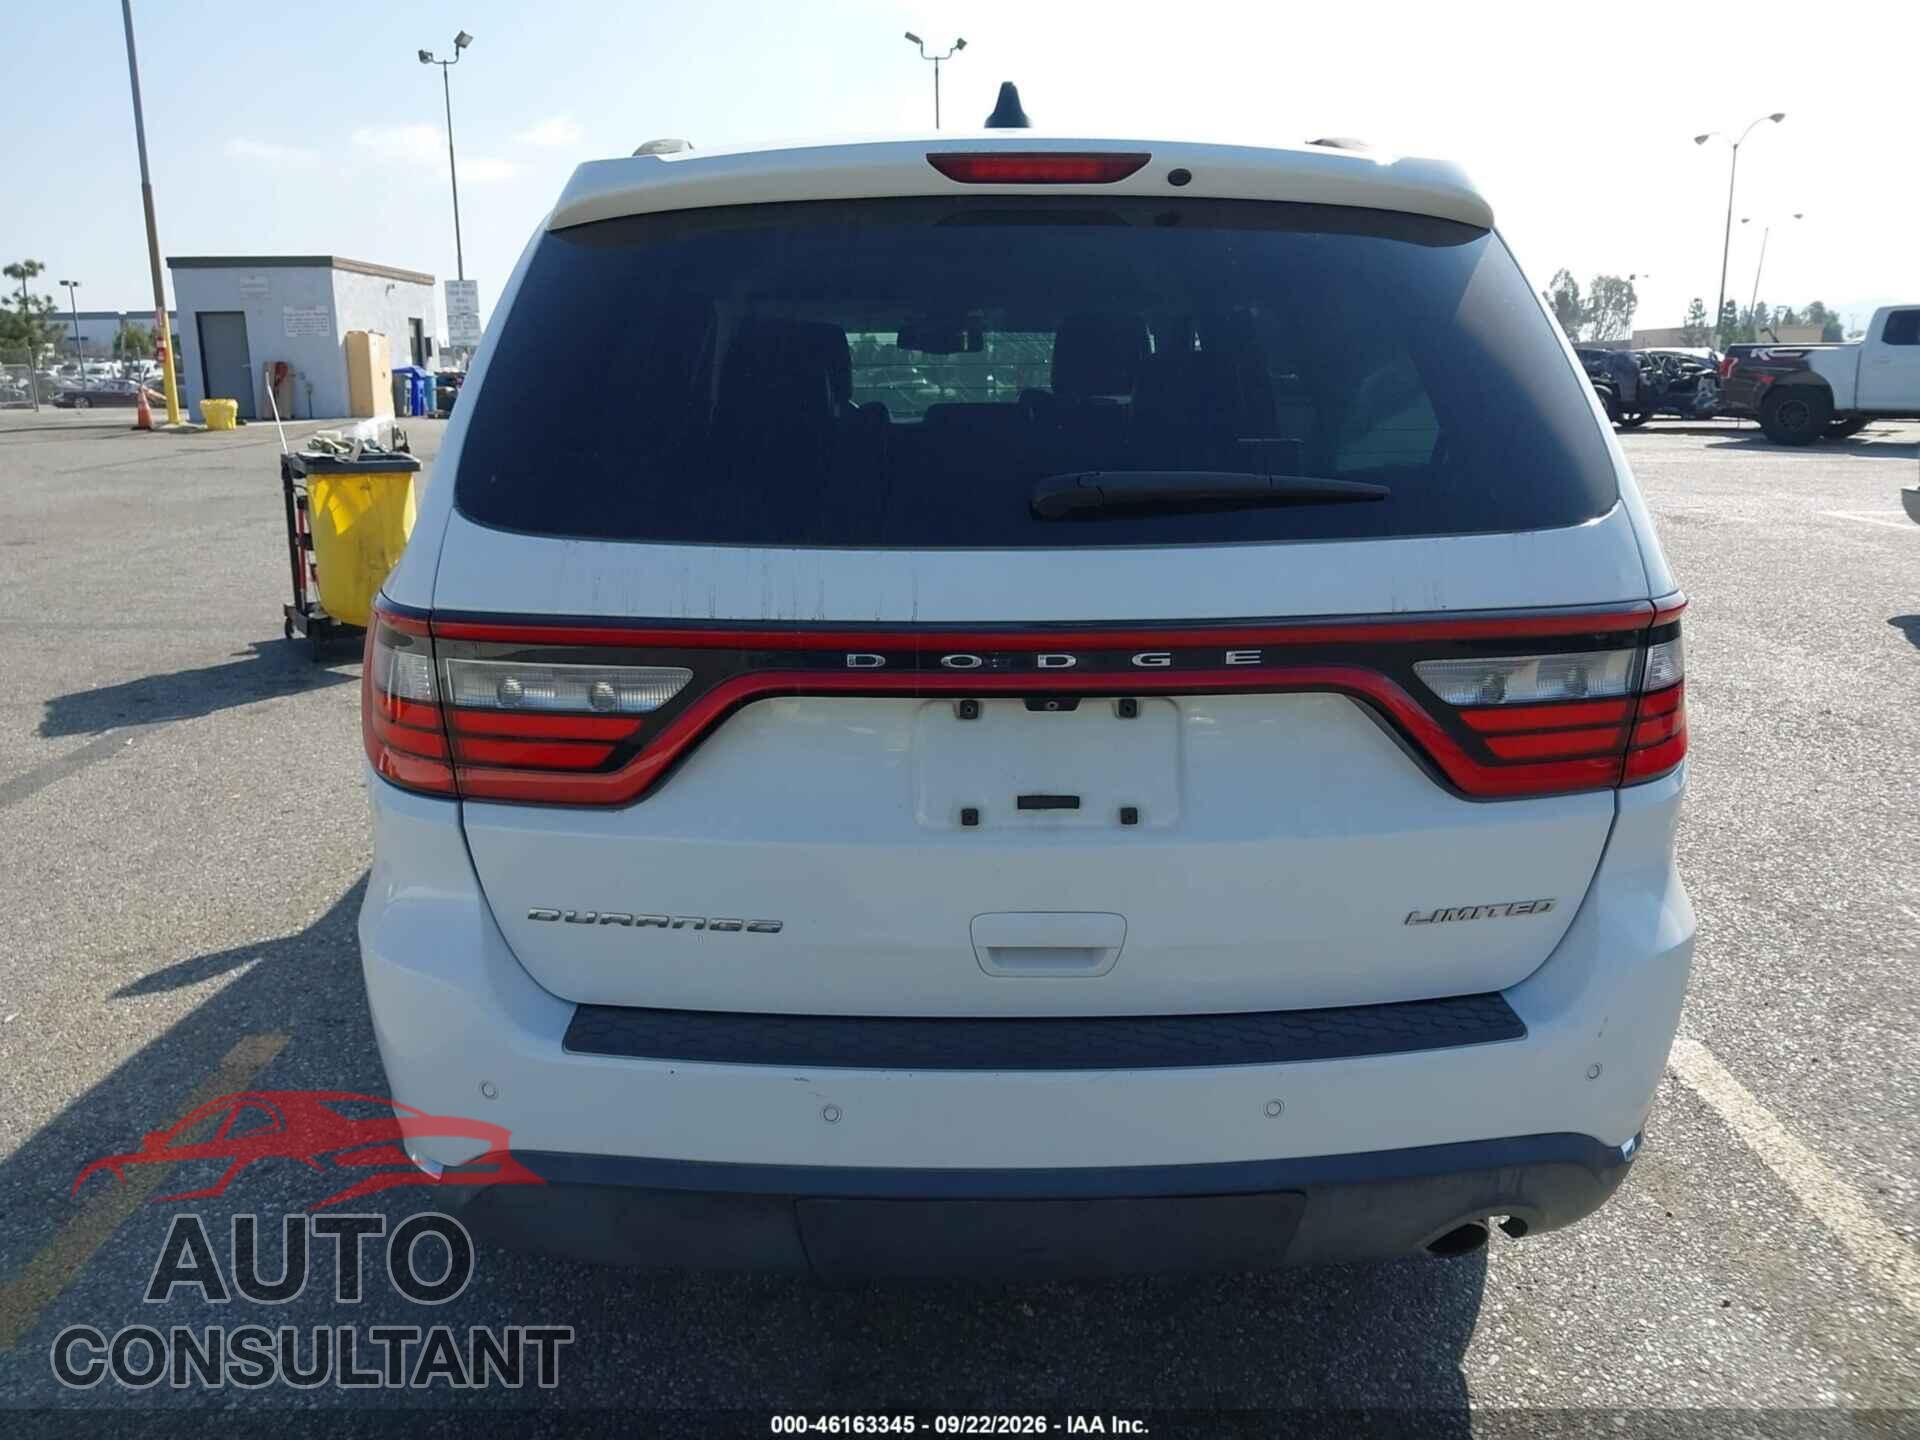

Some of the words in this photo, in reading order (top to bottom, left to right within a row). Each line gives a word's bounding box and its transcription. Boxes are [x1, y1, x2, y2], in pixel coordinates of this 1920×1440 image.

[847, 650, 1262, 668] DODGE
[527, 907, 783, 933] DURANGO
[1404, 898, 1556, 925] LIMITED
